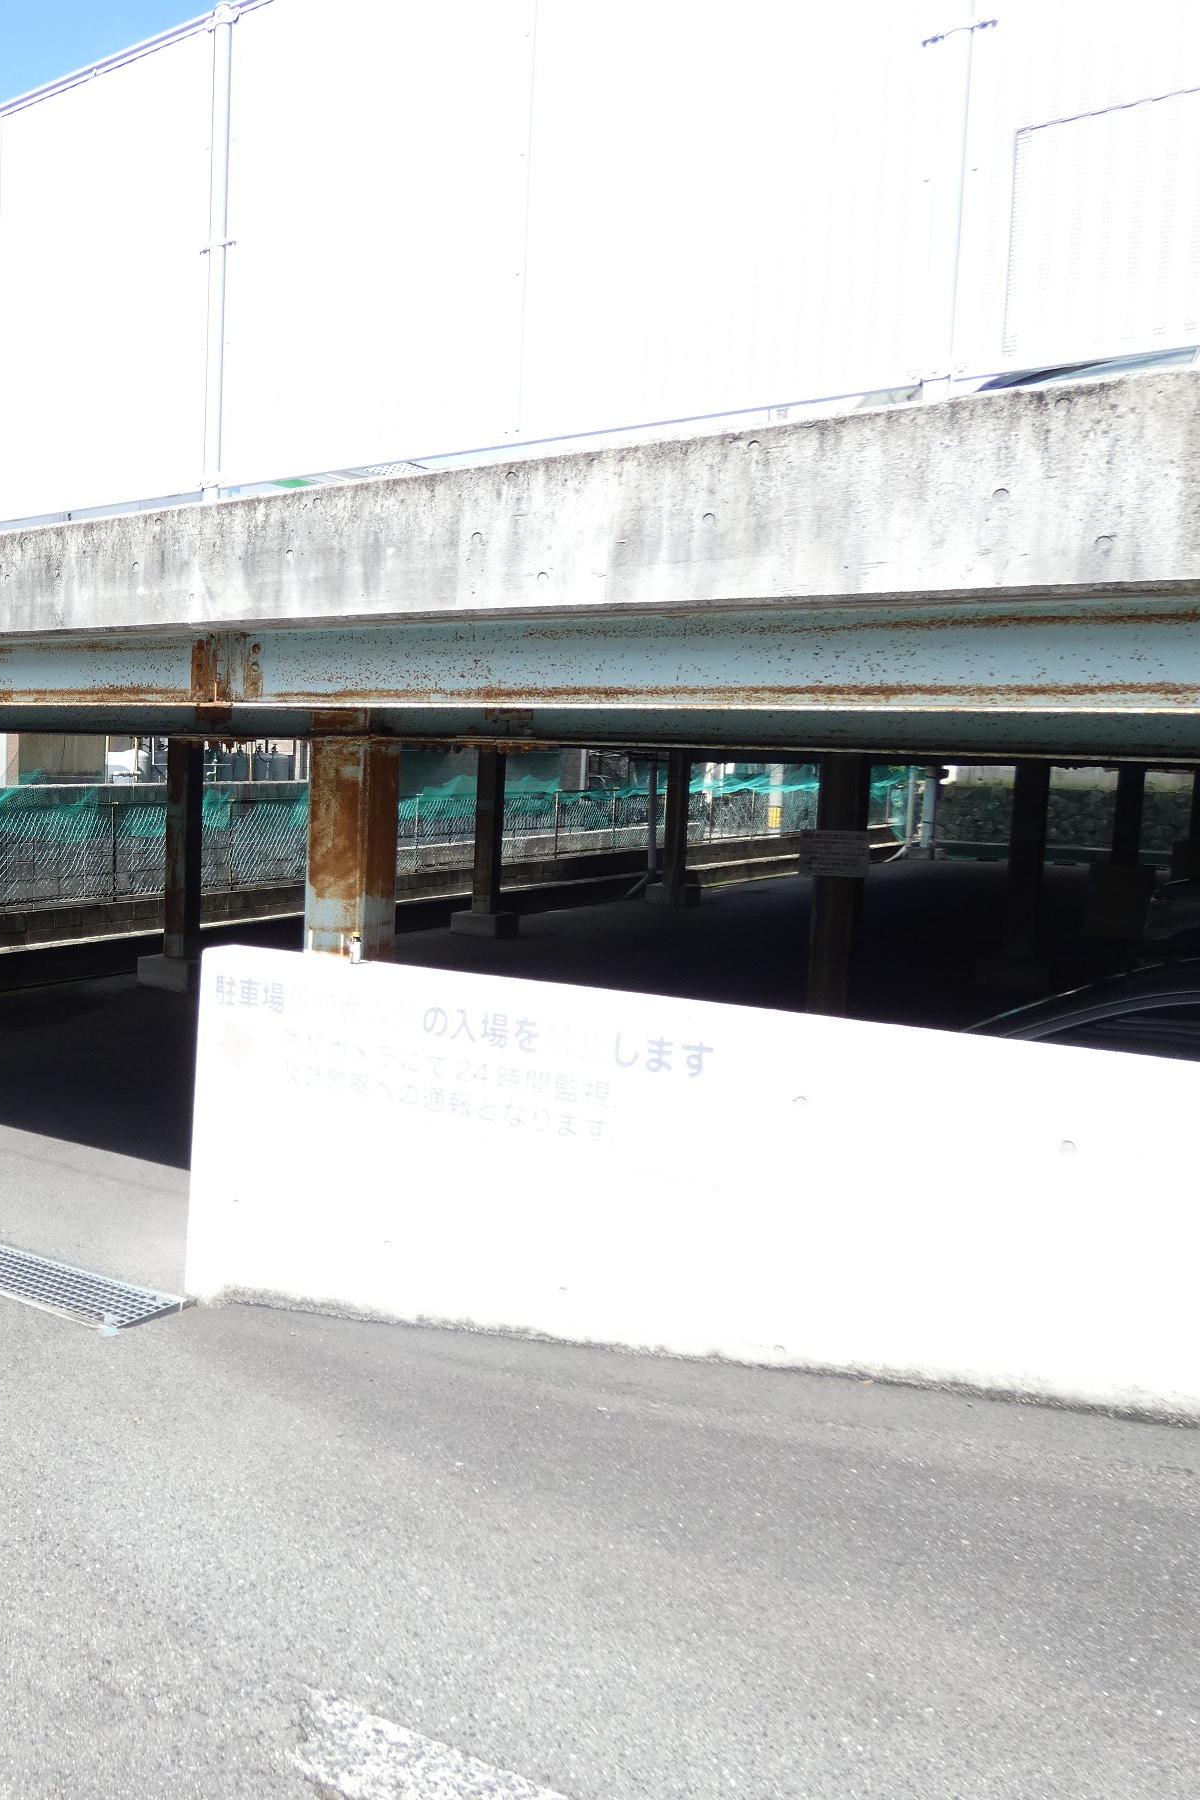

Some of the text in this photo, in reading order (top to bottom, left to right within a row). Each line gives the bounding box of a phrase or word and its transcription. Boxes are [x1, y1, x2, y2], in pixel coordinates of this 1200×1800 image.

[215, 974, 285, 1014] 駐車場
[422, 1006, 539, 1054] の入場を
[613, 1031, 715, 1079] します
